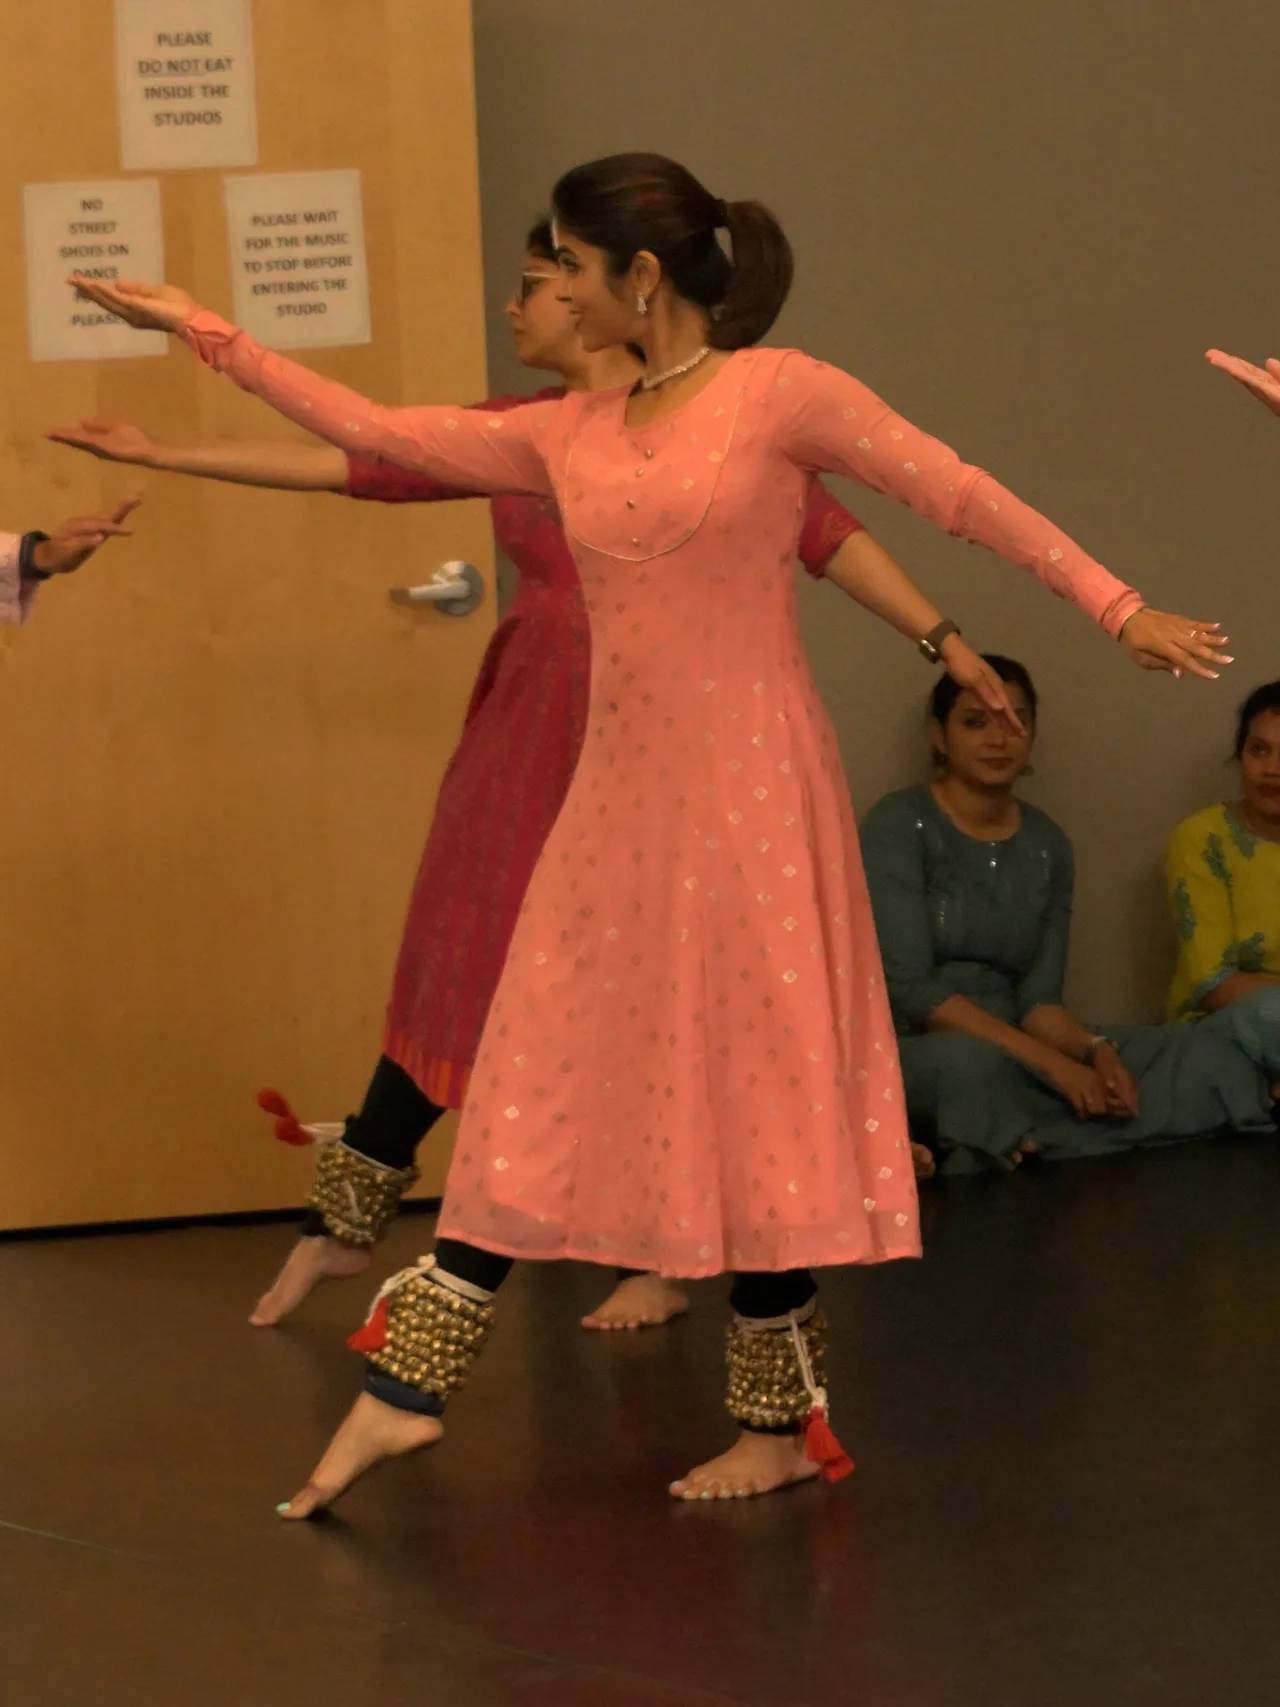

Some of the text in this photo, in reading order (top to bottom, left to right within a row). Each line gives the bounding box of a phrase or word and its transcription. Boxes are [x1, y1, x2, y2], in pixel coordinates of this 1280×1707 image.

[157, 32, 211, 47] PLEASE
[138, 57, 232, 74] DO NOT EAT
[144, 84, 228, 100] INSIDE THE
[154, 111, 222, 127] STUDIOS
[81, 200, 103, 212] NO
[251, 210, 338, 226] PLEASE WAIT
[69, 221, 116, 235] STREET
[245, 232, 349, 250] FOR THE MUSIC
[60, 244, 129, 258] SHOES ON
[244, 256, 352, 273] TO STOP BEFORE
[252, 278, 348, 295] ENTERING THE
[276, 302, 327, 317] STUDIO
